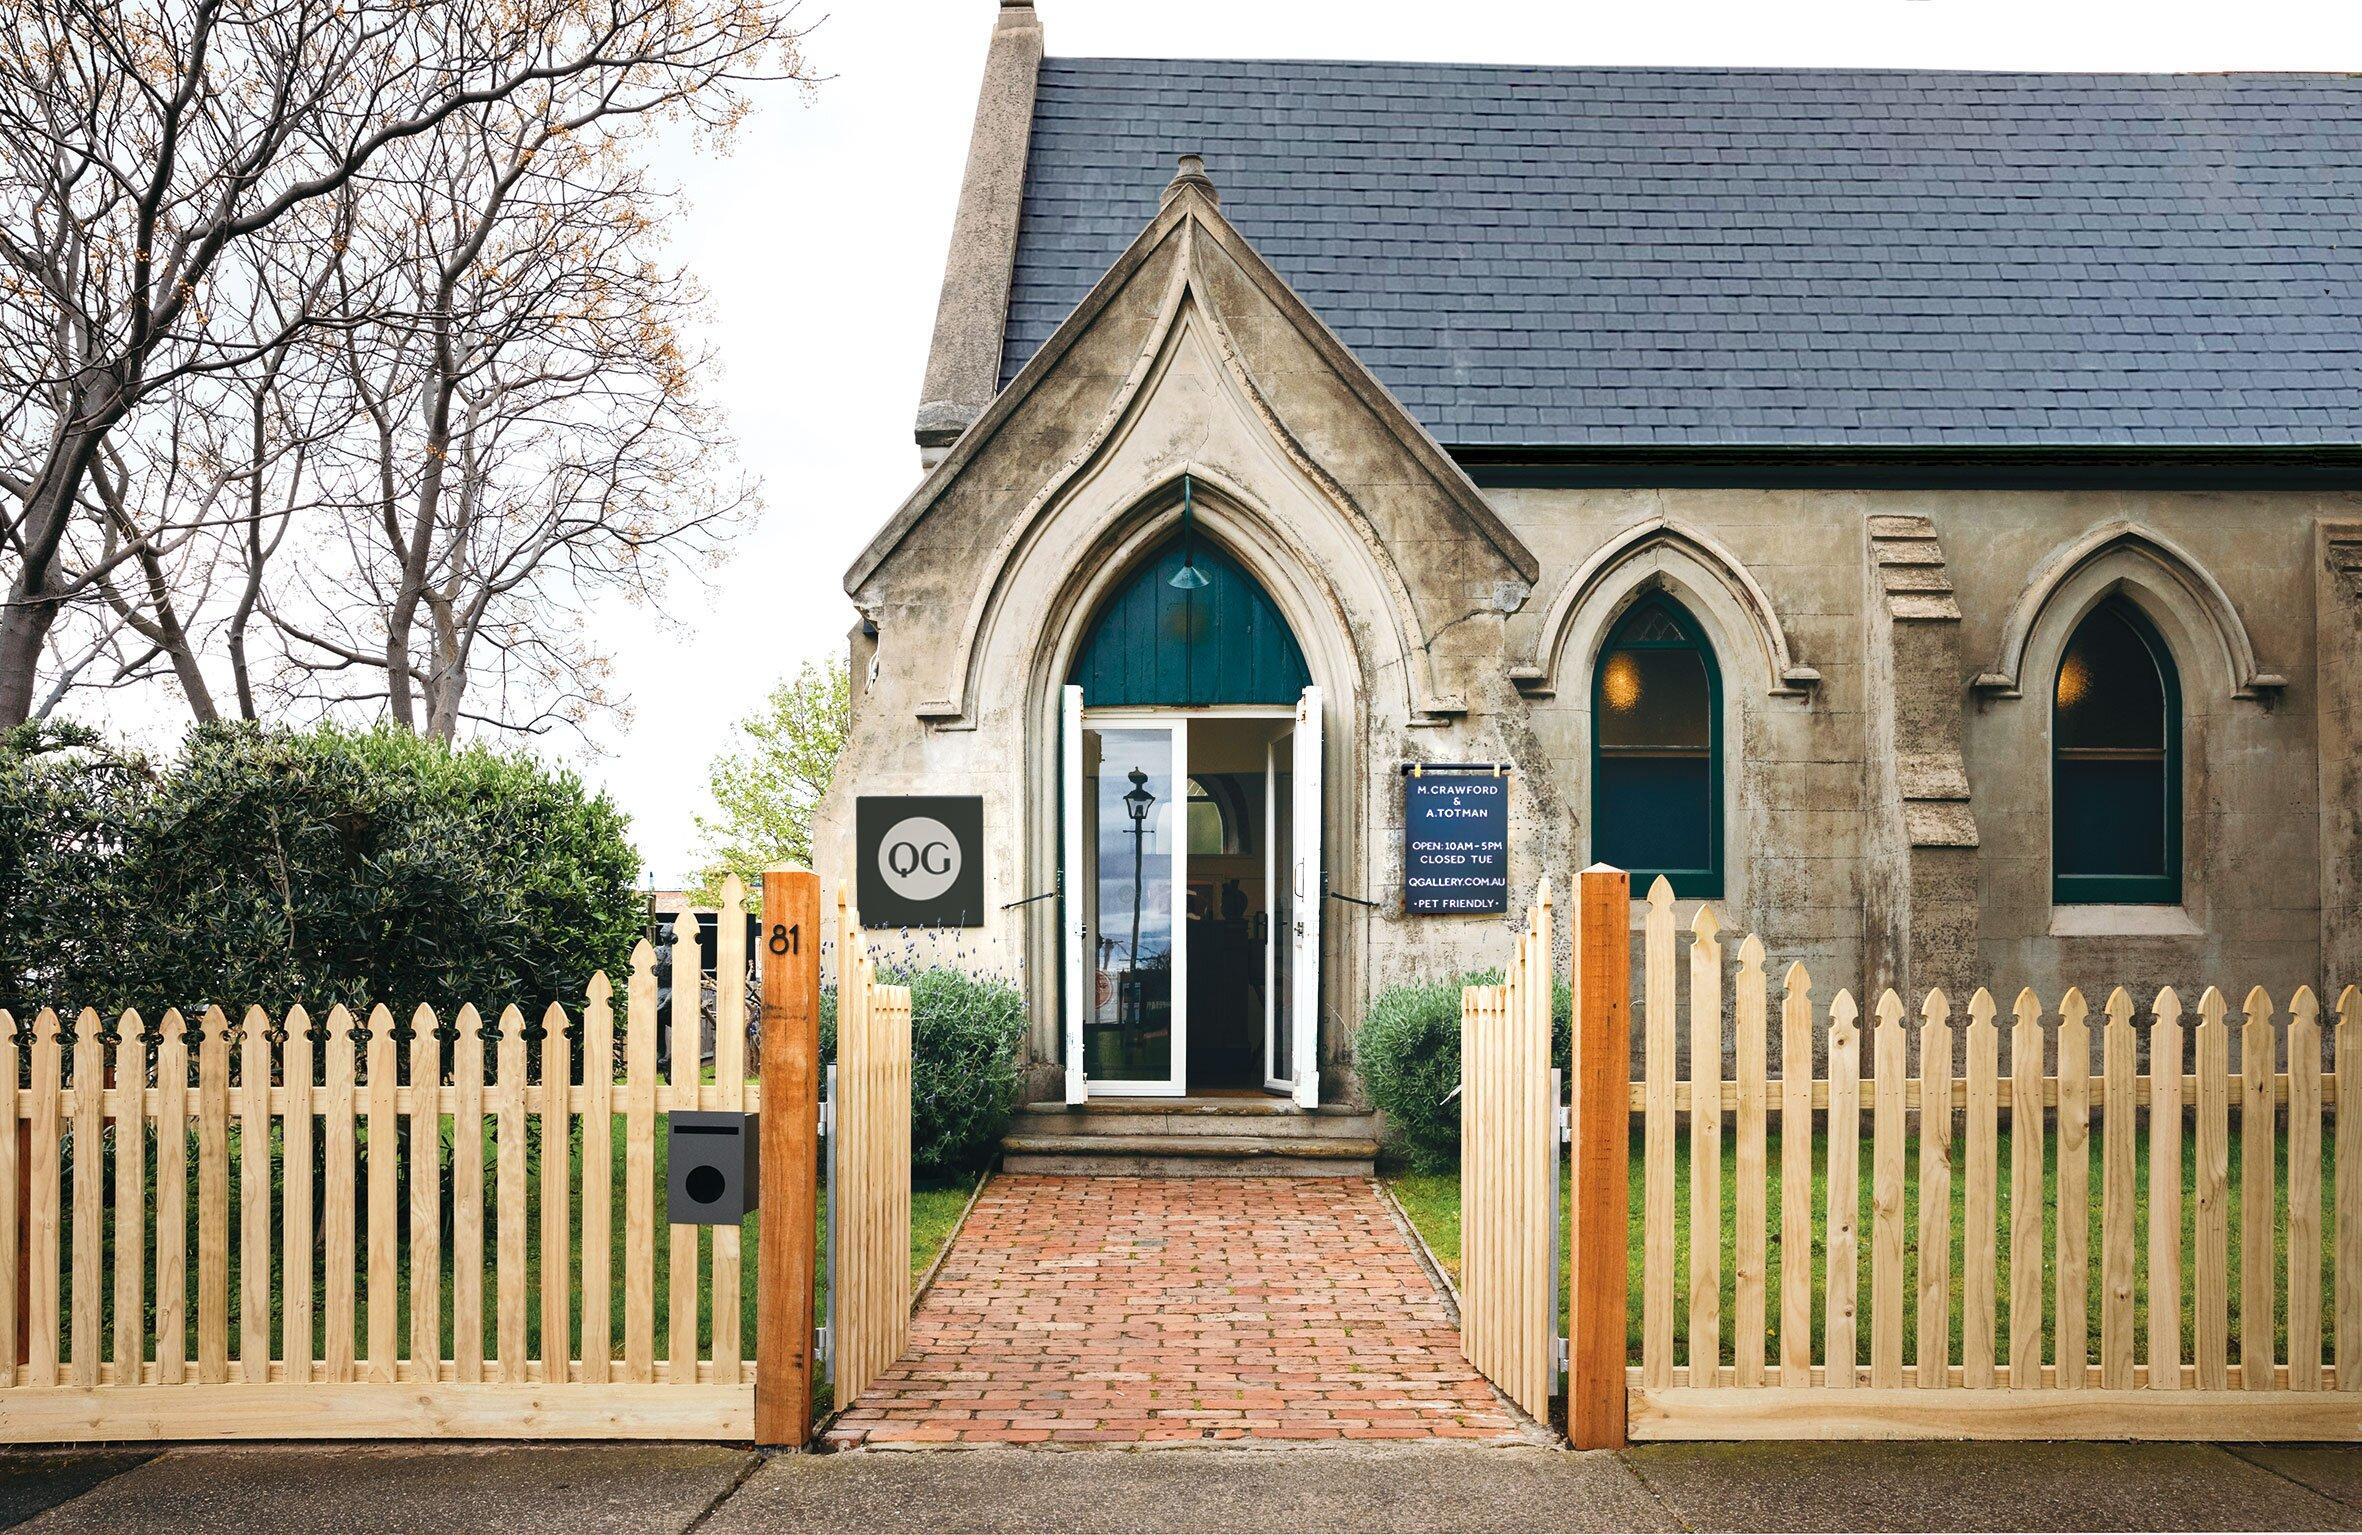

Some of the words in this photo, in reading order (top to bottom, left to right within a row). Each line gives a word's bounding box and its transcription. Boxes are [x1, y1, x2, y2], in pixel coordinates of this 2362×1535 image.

[1417, 785, 1498, 795] M.CRAWFORD
[1453, 797, 1461, 806] &
[1426, 809, 1488, 818] A.TOTMAN
[888, 841, 951, 878] QG
[1420, 855, 1466, 864] CLOSED
[1471, 855, 1493, 864] TUE
[1408, 877, 1506, 887] QGALLERY.COM.AU
[769, 924, 799, 955] 81
